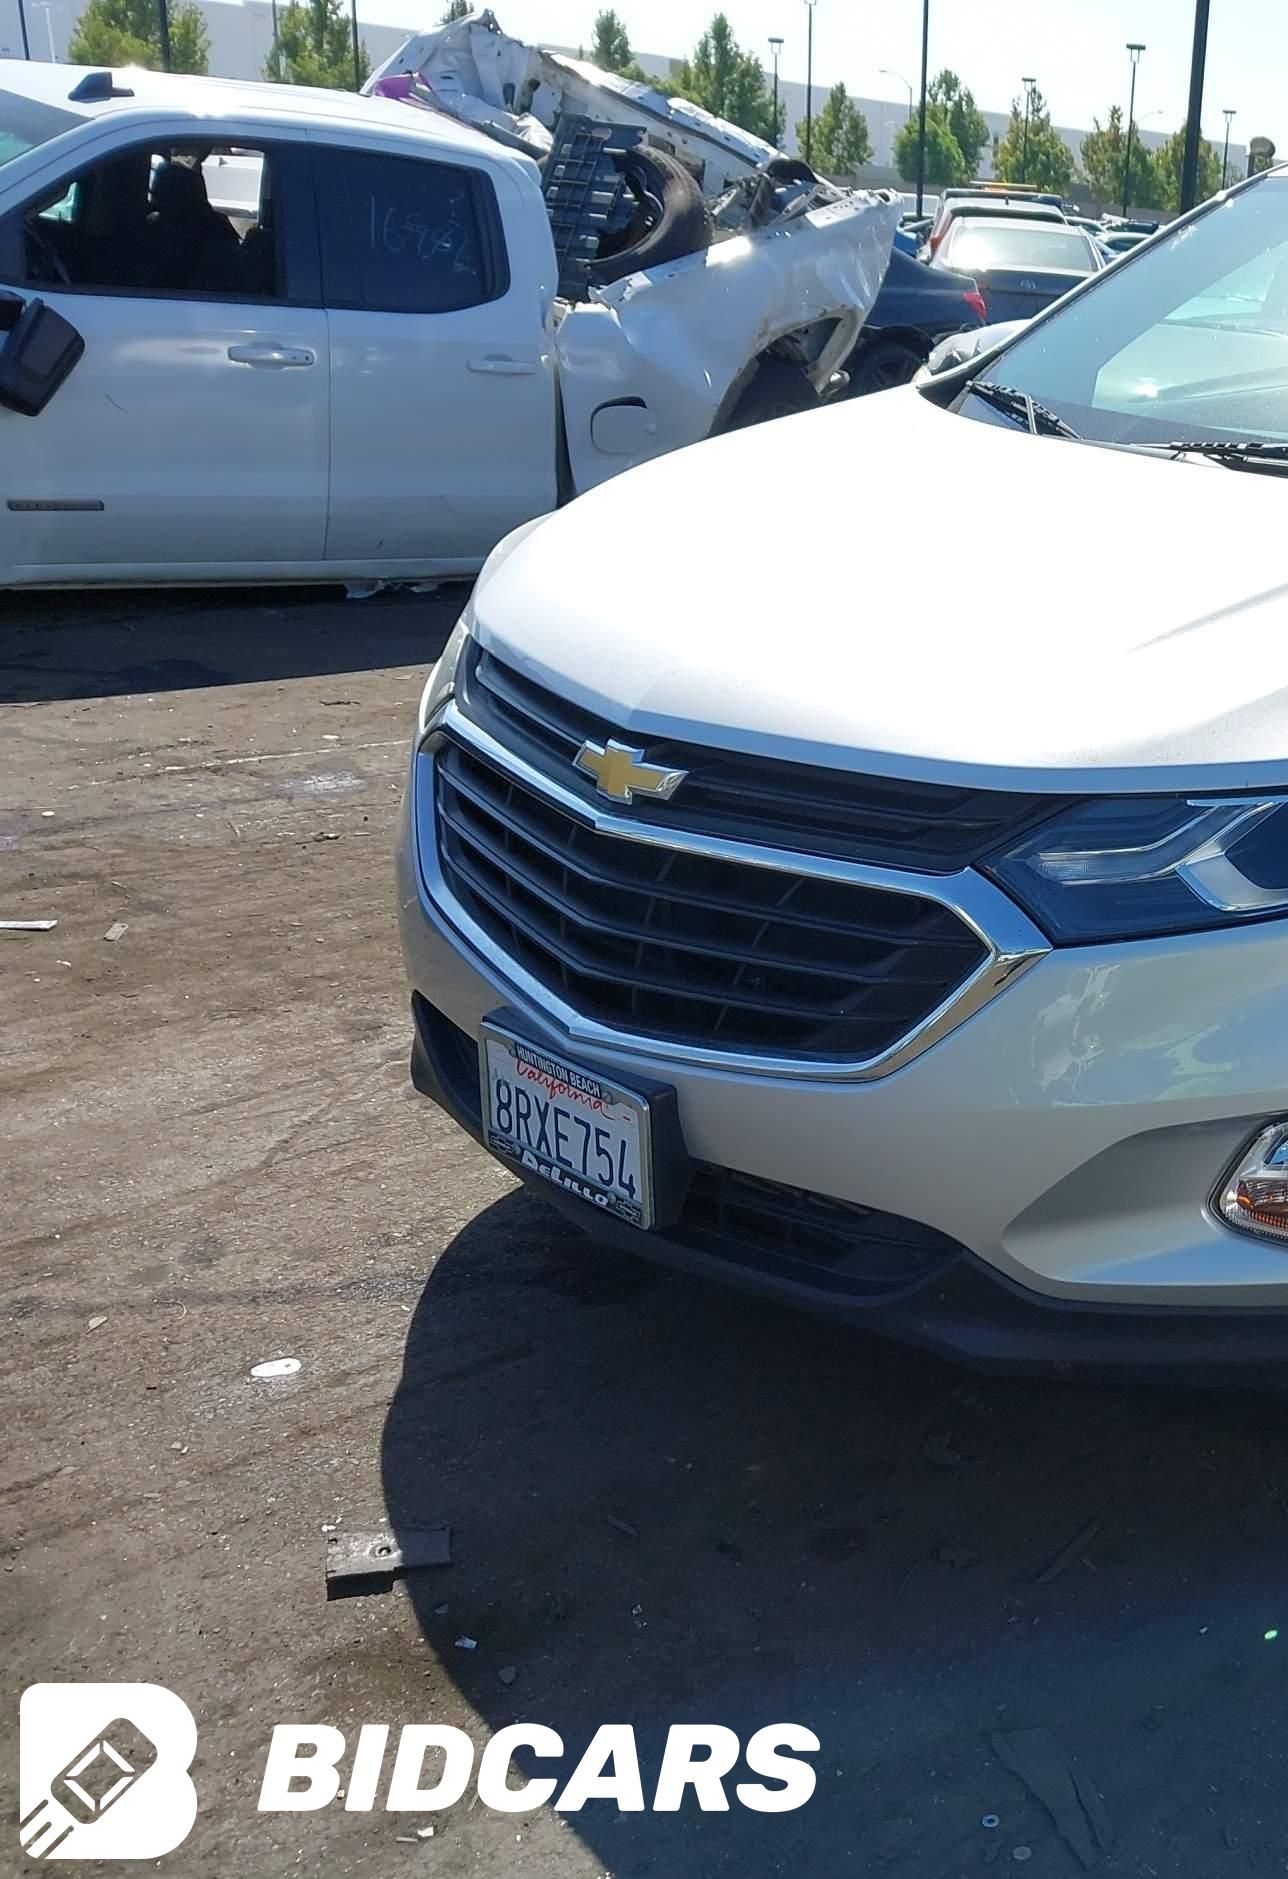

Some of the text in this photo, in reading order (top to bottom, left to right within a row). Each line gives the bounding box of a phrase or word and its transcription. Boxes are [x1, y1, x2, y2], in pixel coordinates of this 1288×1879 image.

[516, 1043, 602, 1098] HUNTINGTON BEACH
[495, 1078, 636, 1199] 8RXE754
